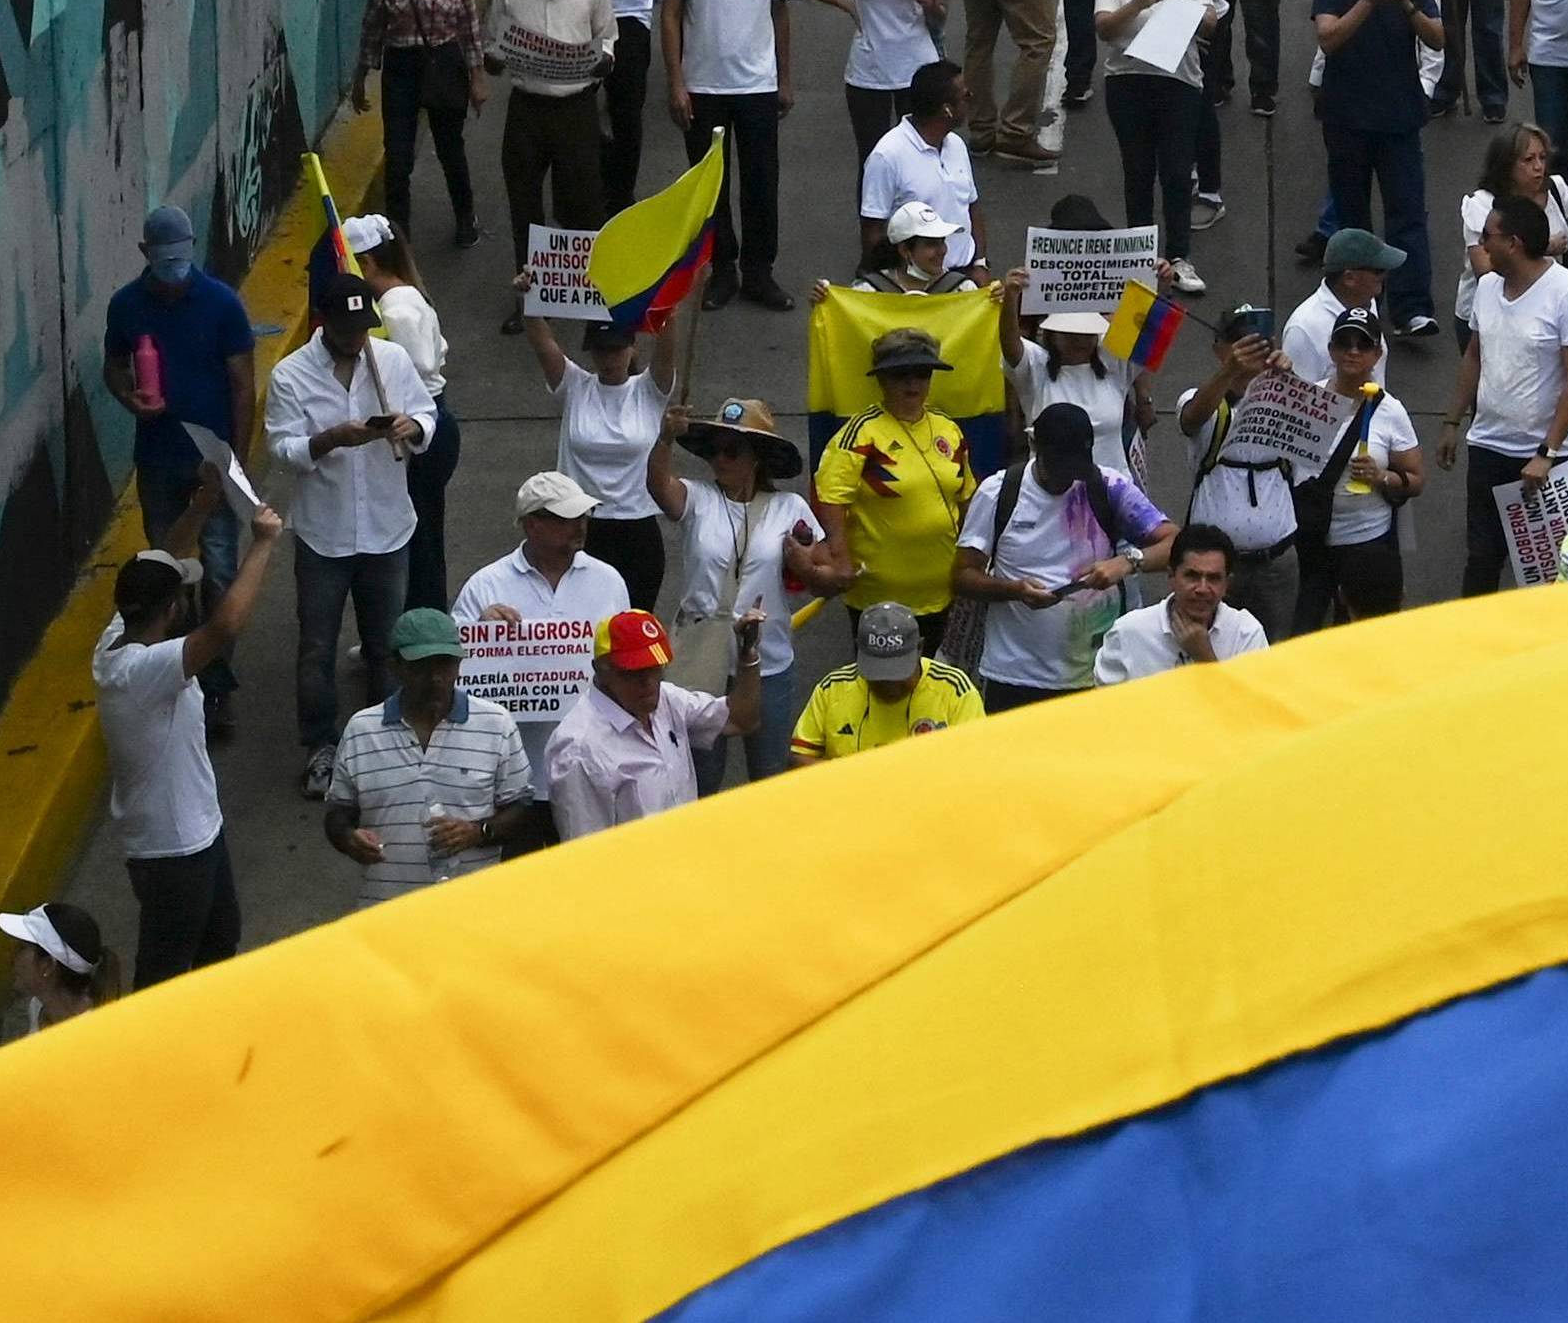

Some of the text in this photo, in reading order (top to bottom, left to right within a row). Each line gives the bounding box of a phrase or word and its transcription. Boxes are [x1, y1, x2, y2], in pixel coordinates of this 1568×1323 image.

[504, 30, 596, 60] MINDEFENSA
[510, 24, 589, 52] #RENUNCIE
[550, 233, 569, 252] UN
[1032, 233, 1155, 256] #RENUNCIE IRENE MINMINAS
[1030, 258, 1155, 270] DESCONOCIMIENTO
[1062, 270, 1123, 281] TOTAL...
[540, 288, 569, 305] QUE
[571, 289, 581, 305] A
[1044, 293, 1052, 302] E
[1288, 389, 1329, 412] DE LA
[1321, 389, 1339, 405] EL
[1291, 402, 1338, 426] PARA?
[1285, 424, 1321, 443] RIEGO
[1506, 502, 1540, 584] UN GOBIERNO
[495, 621, 594, 643] PELIGROSA
[868, 633, 904, 647] BOSS
[516, 643, 591, 658] ELECTORAL
[456, 670, 590, 687] TRAERÍA DICTADURA,
[526, 684, 559, 697] CON
[562, 683, 579, 696] LA
